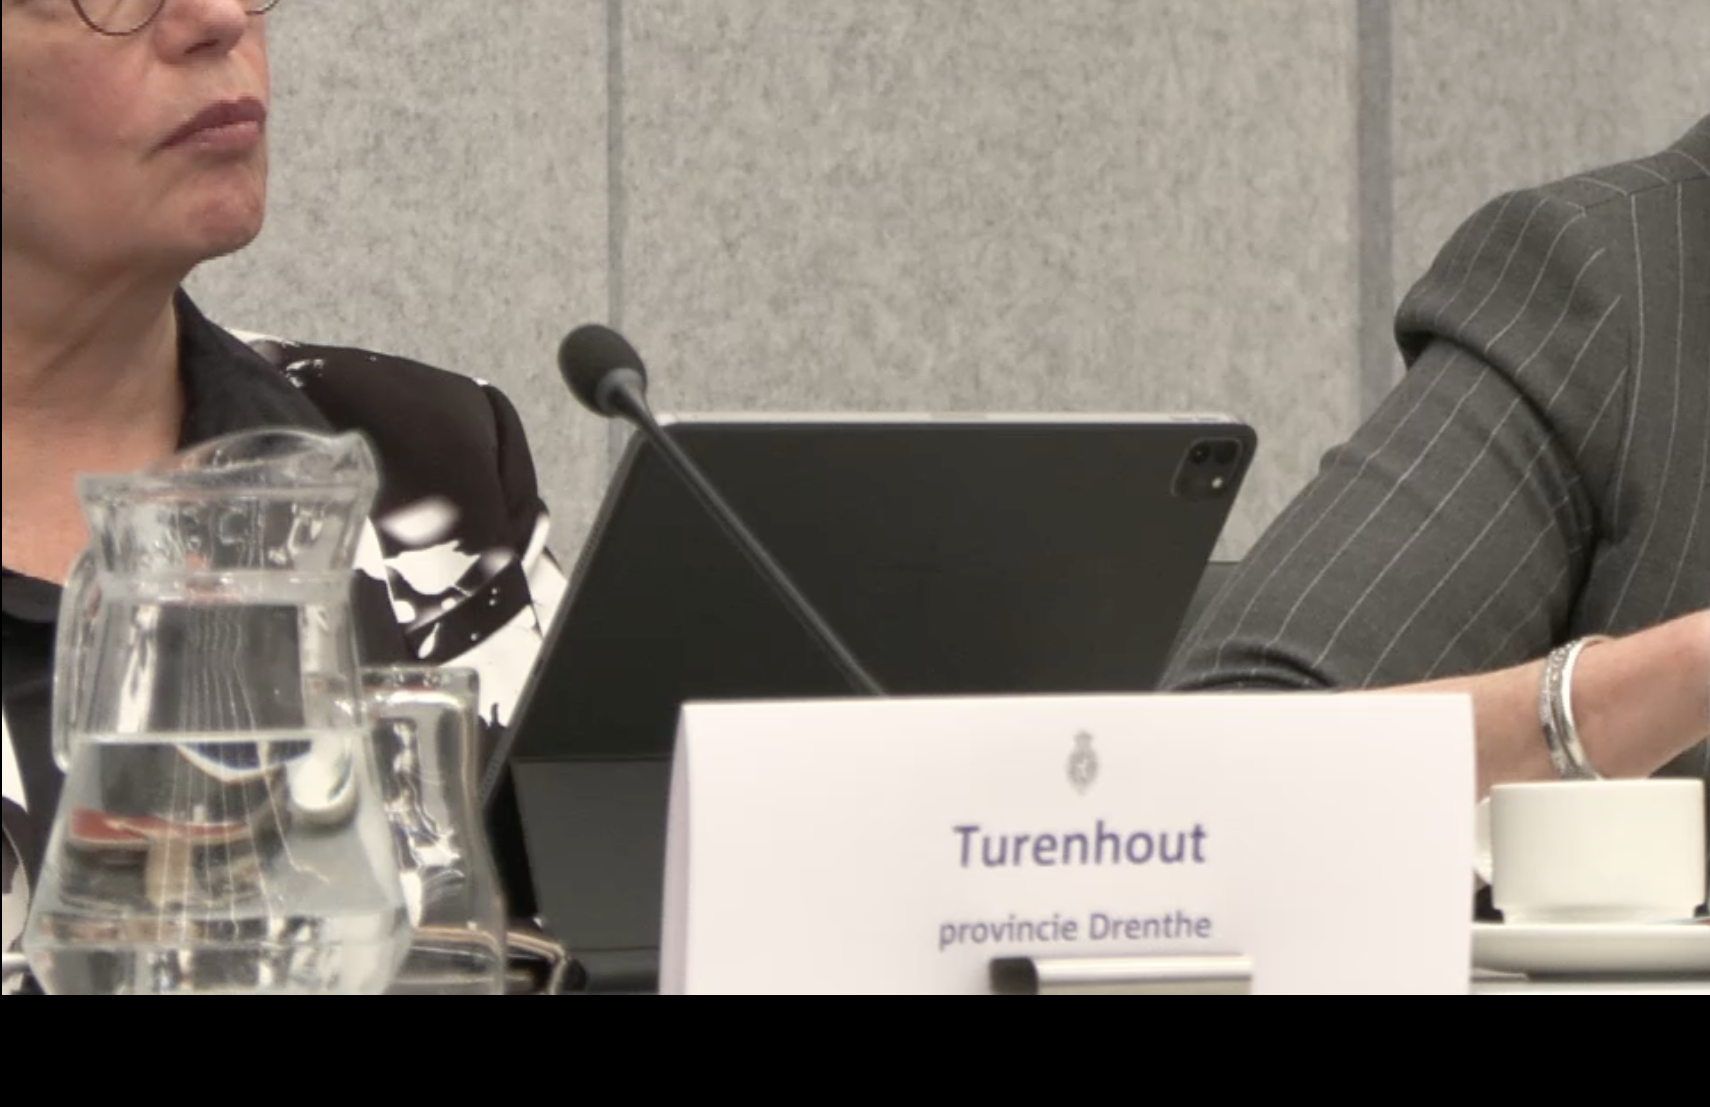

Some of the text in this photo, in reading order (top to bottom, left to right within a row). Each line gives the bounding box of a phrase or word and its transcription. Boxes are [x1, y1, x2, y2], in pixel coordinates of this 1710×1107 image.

[952, 818, 1208, 868] Turenhout
[938, 909, 1213, 952] provincie Drenthe
